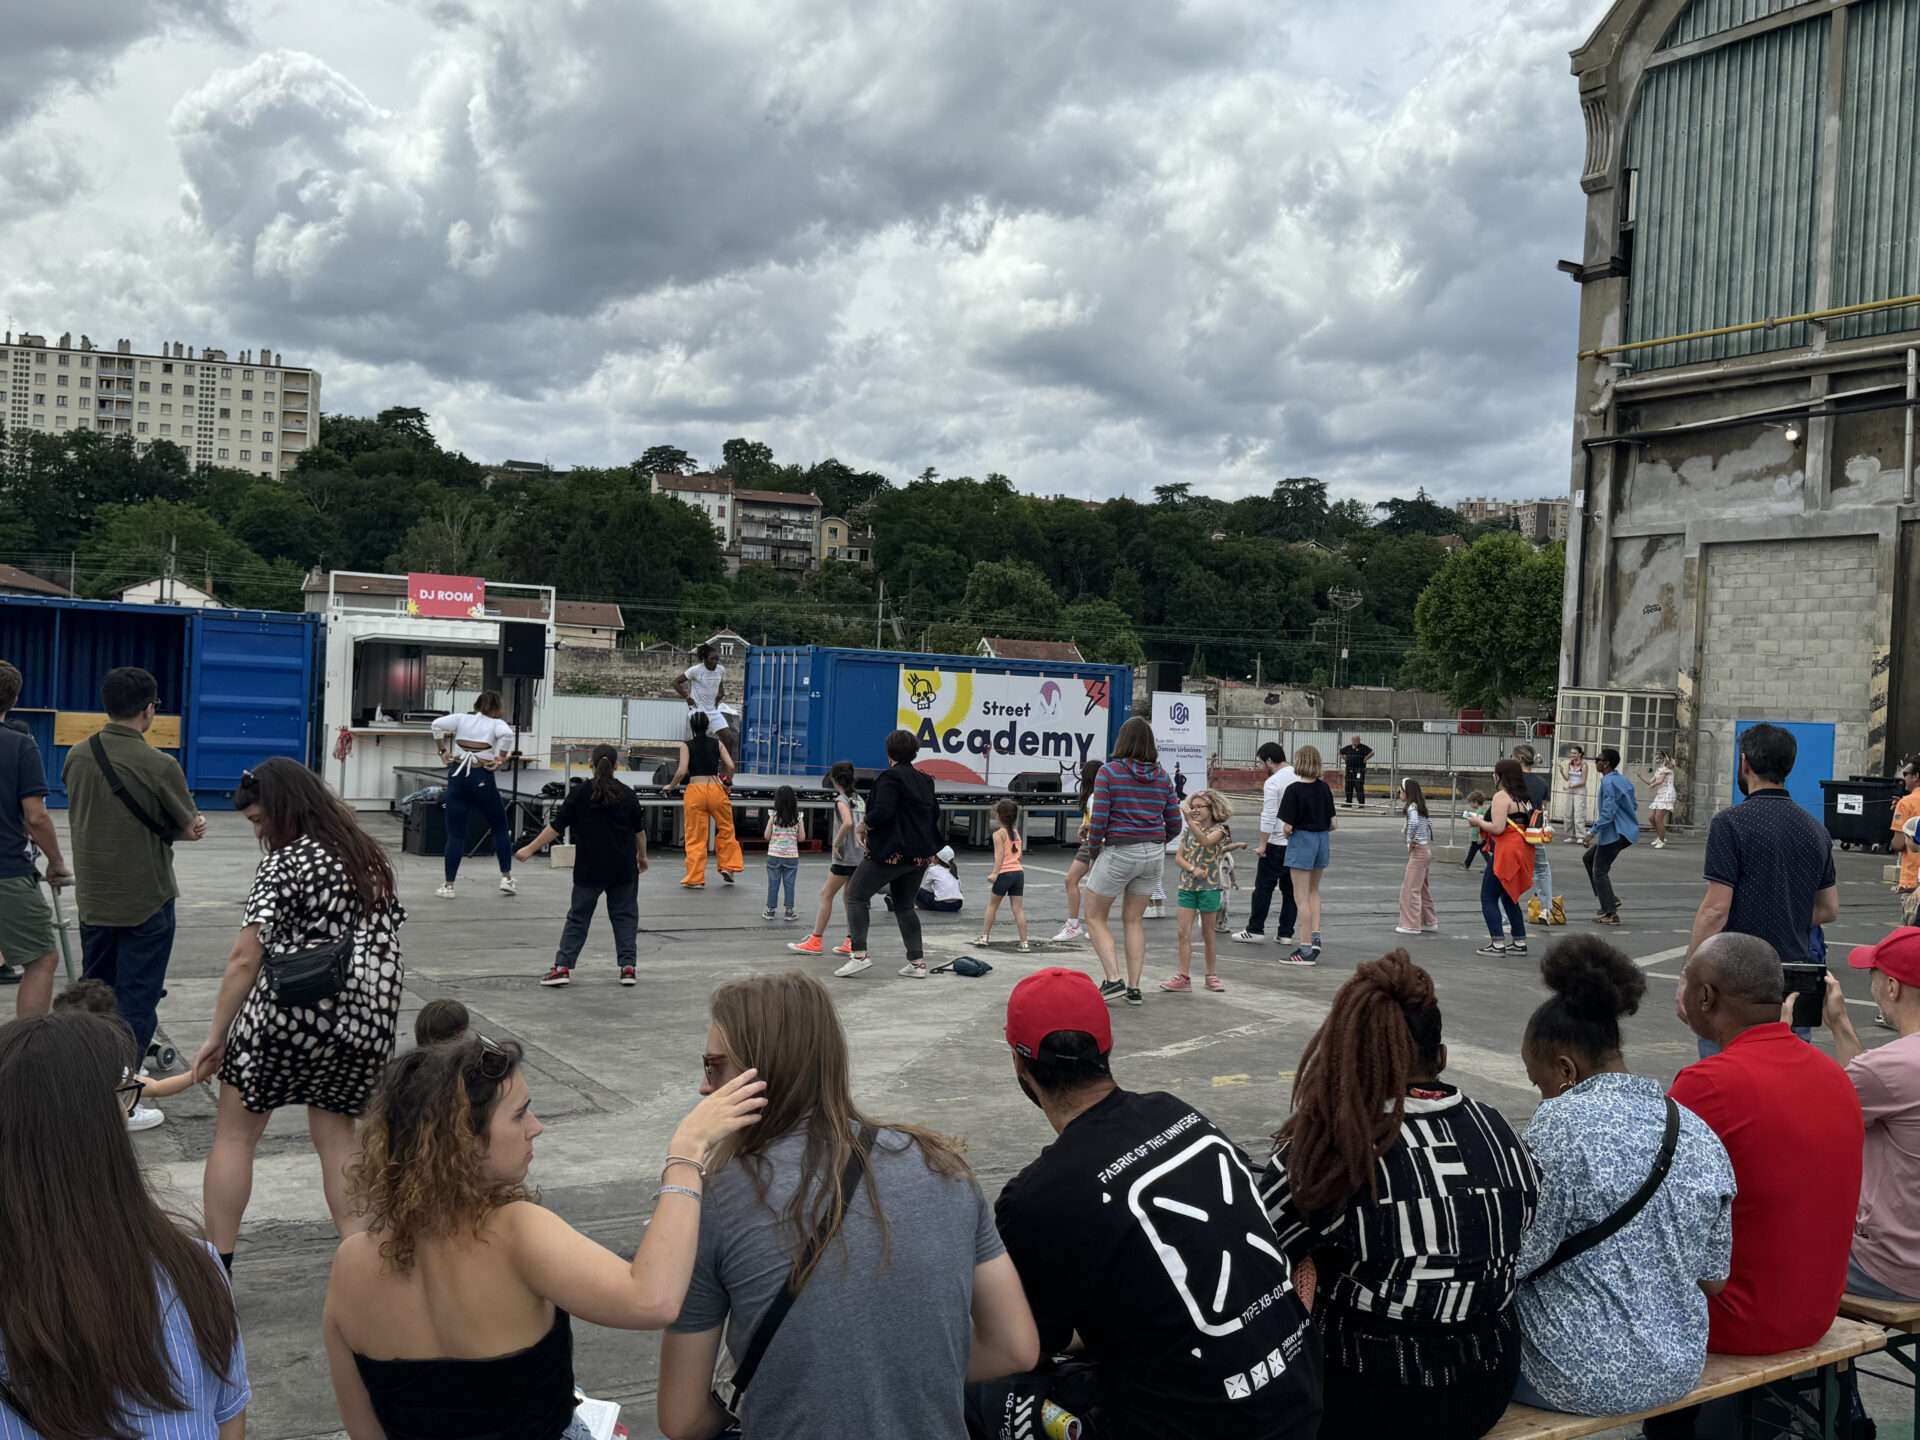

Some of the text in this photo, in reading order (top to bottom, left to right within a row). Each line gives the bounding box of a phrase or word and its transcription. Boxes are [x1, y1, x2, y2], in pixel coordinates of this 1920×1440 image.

[419, 589, 474, 603] DJ ROOM
[982, 701, 1031, 717] Street
[917, 717, 1095, 769] Academy
[1097, 1112, 1201, 1184] FABRIC OF THE UNIVERSE
[1241, 1301, 1261, 1325] TYPE
